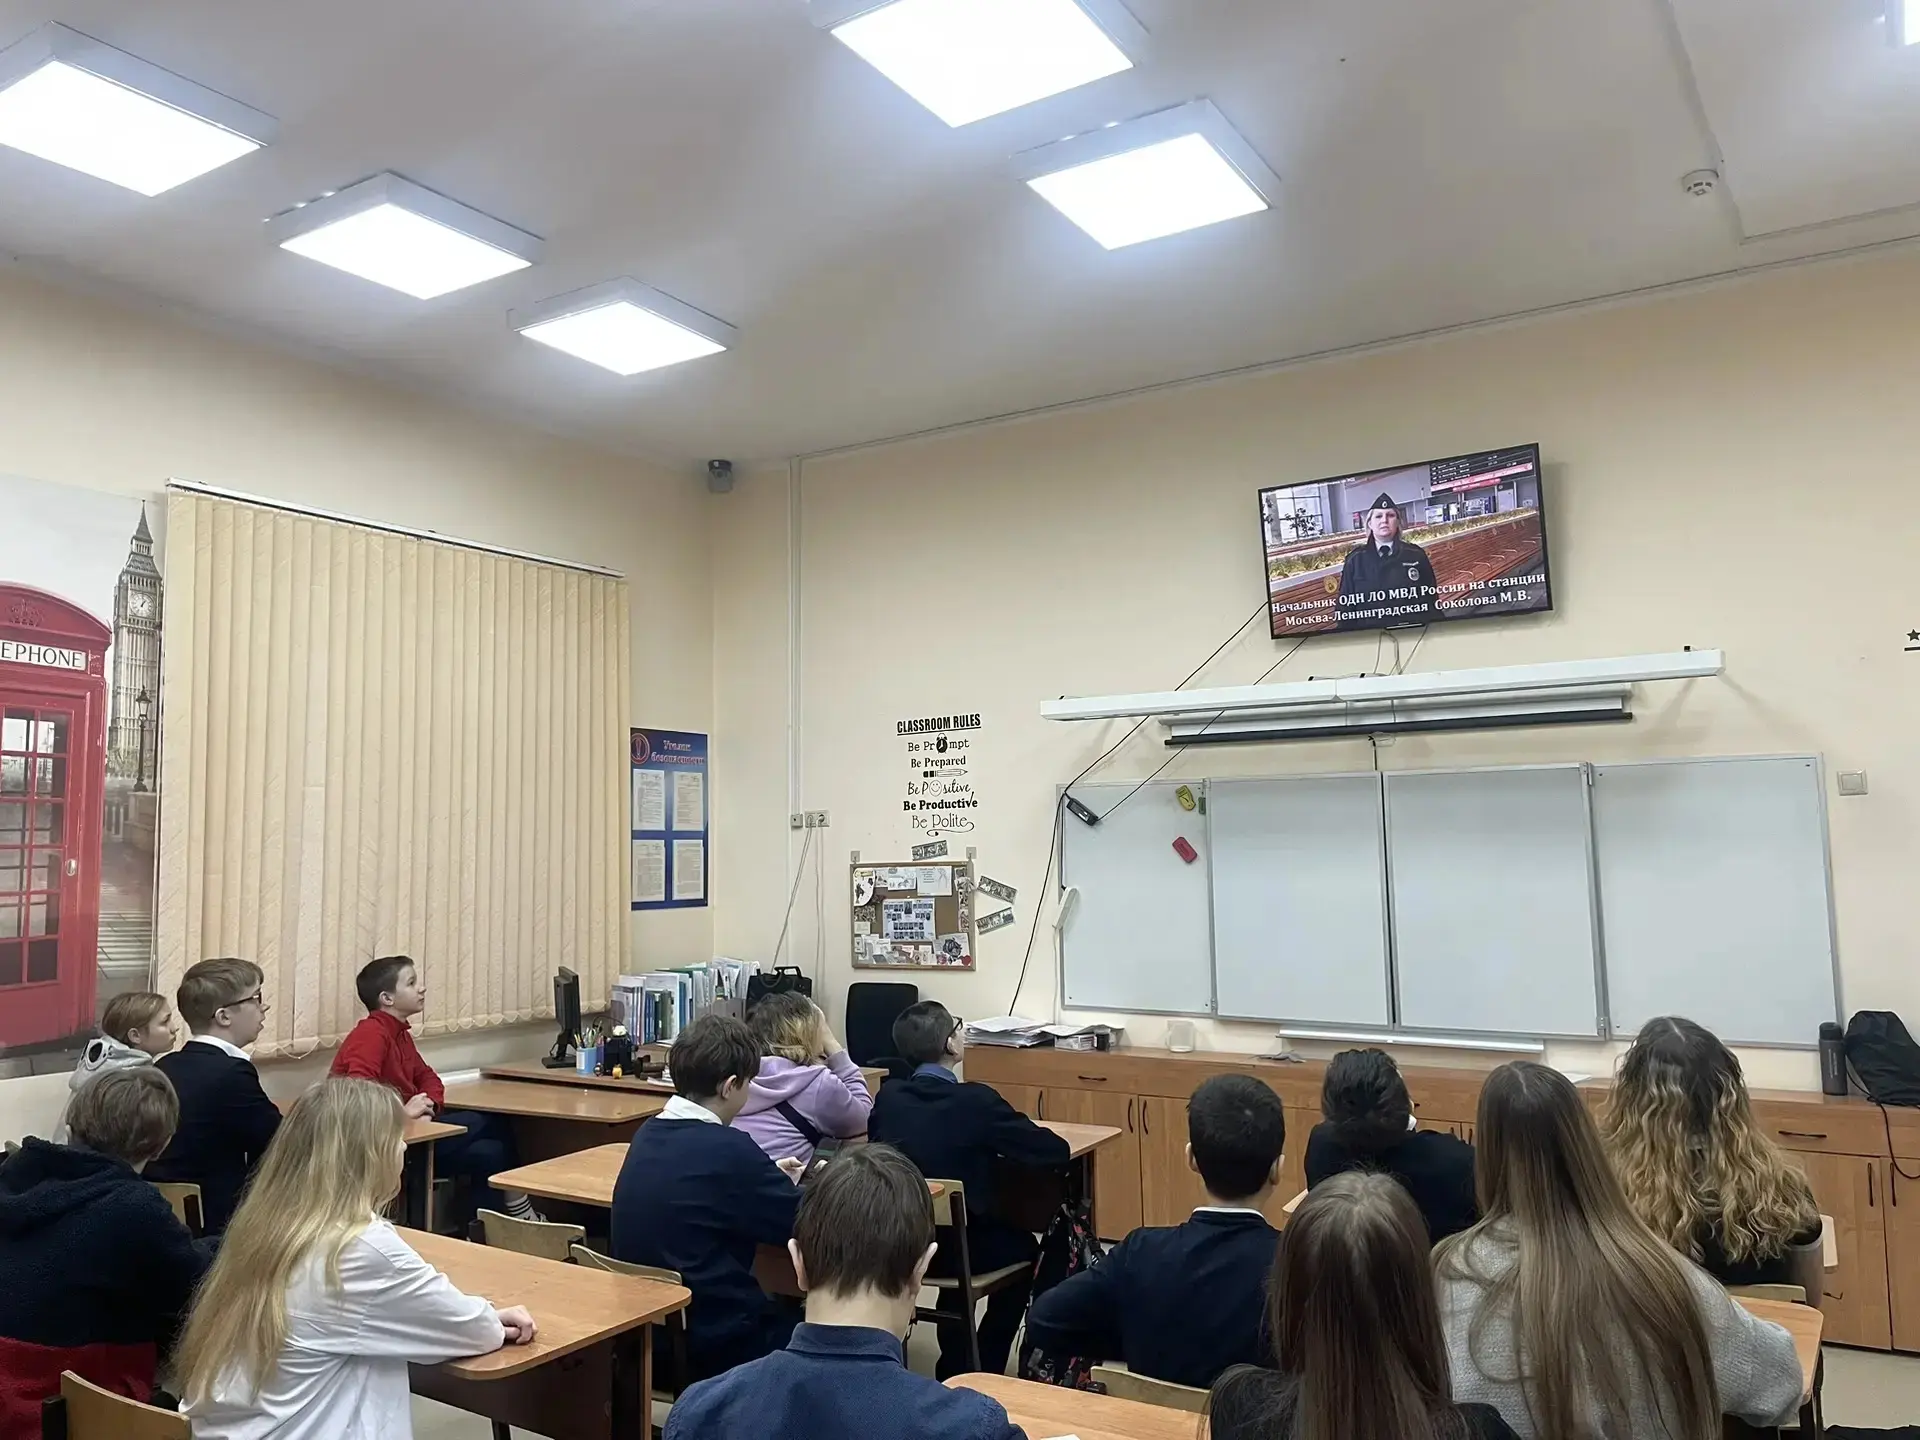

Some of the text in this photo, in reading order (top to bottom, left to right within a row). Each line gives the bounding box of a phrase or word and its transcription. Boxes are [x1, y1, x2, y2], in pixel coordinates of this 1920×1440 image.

[1272, 572, 1546, 613] Начальник ОДН ЛО МВД России на станции
[1285, 589, 1532, 626] Москва-Ленинградская Соколова М.В.
[1, 642, 82, 668] EPHONE
[897, 713, 981, 733] CLASSROOM RULES
[907, 742, 920, 752] Be
[911, 755, 967, 769] Be Prepared
[907, 780, 921, 796] Be
[903, 795, 978, 811] Be Productive
[912, 812, 972, 830] Be Polite
